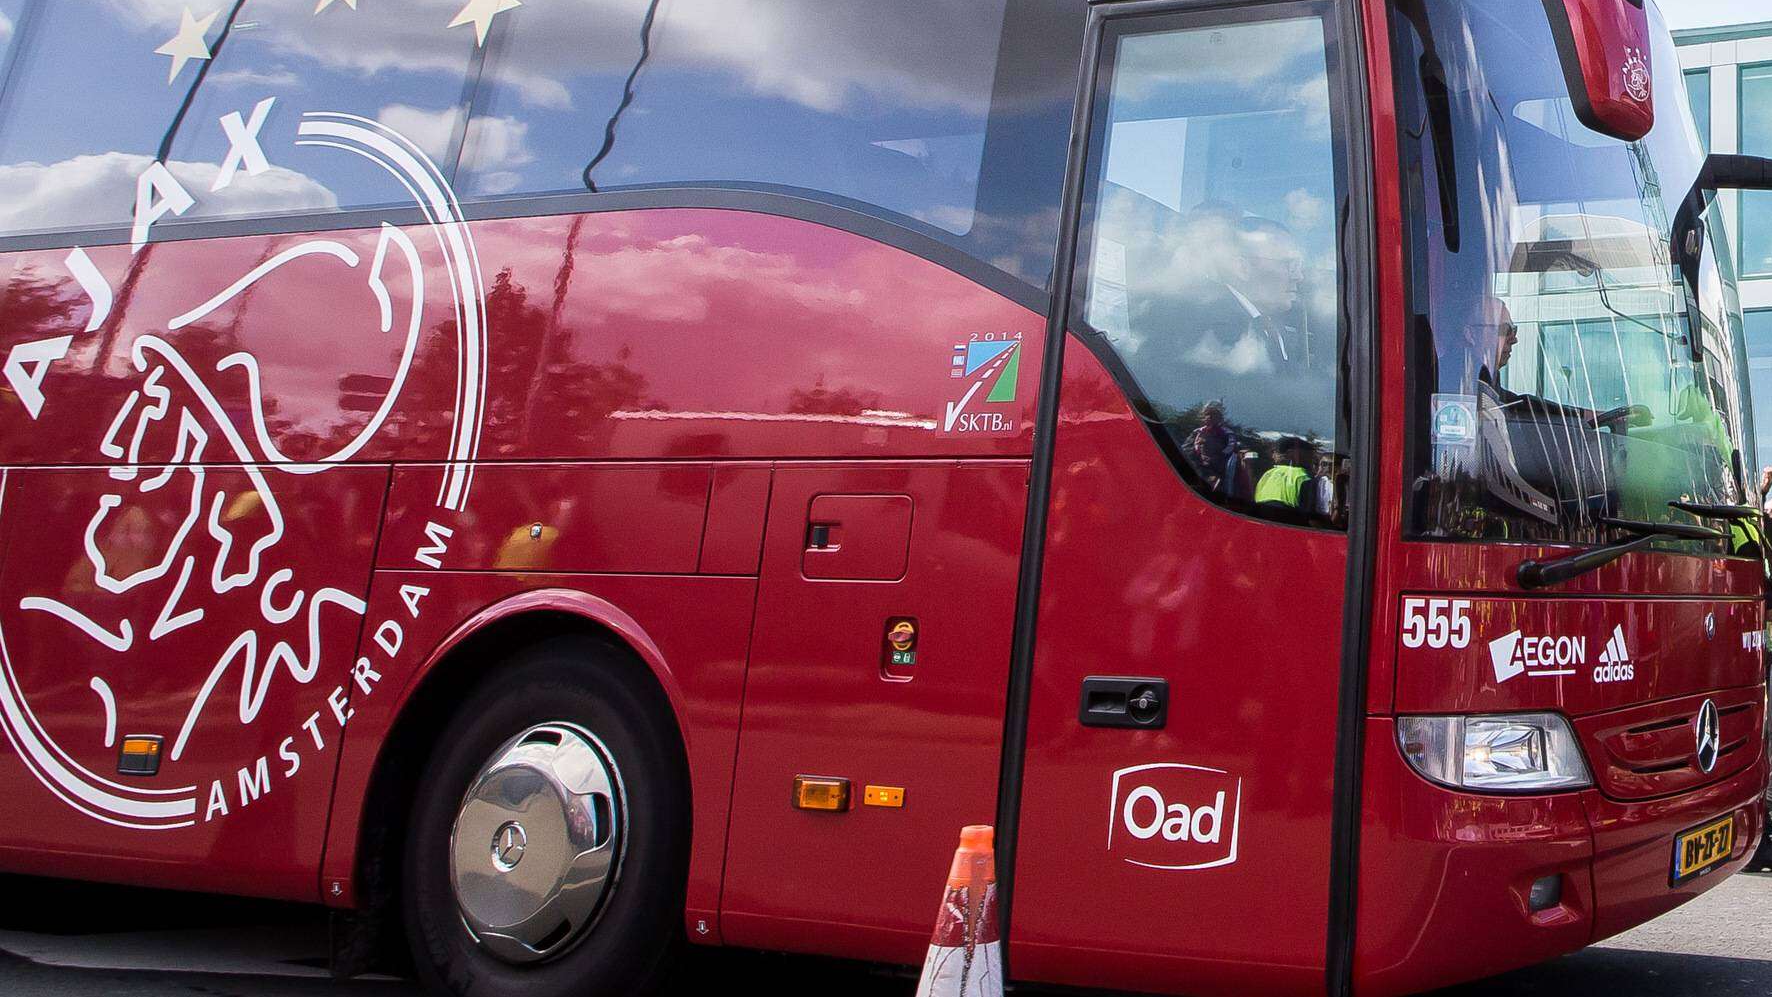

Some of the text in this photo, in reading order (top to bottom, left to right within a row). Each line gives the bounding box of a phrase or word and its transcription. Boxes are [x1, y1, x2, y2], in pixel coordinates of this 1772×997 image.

[2, 96, 277, 420] AJAX
[970, 331, 1023, 342] 2014
[1402, 598, 1472, 649] 555
[202, 521, 455, 823] AMSTERDAM
[1509, 635, 1586, 667] AEGON
[1593, 659, 1634, 683] adidas
[1123, 785, 1226, 844] Oad
